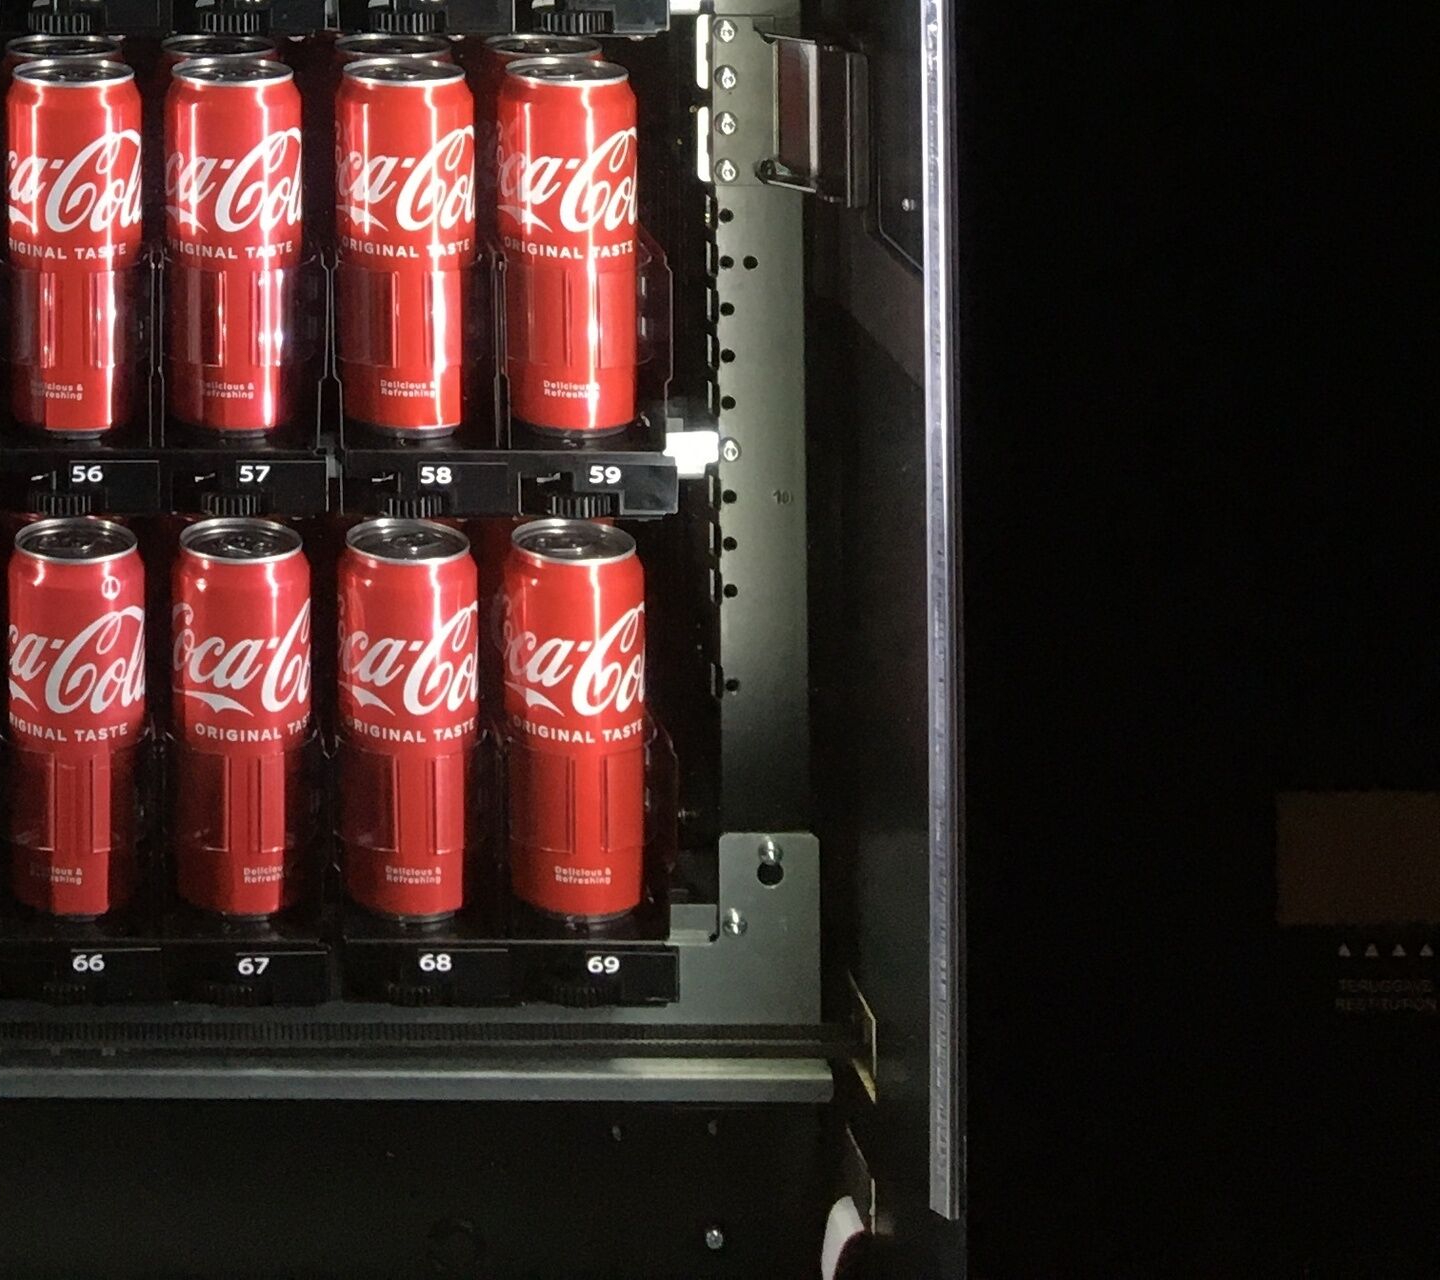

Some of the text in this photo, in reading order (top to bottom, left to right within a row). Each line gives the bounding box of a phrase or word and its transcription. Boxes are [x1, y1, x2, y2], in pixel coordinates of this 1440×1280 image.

[74, 243, 127, 260] TASTE
[245, 241, 293, 259] TASTE
[342, 236, 470, 258] ORIGINAL TASTE
[504, 237, 634, 259] ORIGINAL TASTE
[71, 465, 103, 483] 56
[239, 465, 271, 483] 57
[420, 466, 453, 485] 58
[588, 465, 622, 485] 59
[74, 722, 128, 742] TASTE
[195, 723, 282, 742] ORIGINAL
[347, 715, 475, 743] ORIGINAL TASTE
[514, 715, 643, 743] ORIGINAL TASTE
[72, 954, 105, 972] 66
[238, 957, 270, 975] 67
[419, 953, 452, 972] 68
[587, 956, 620, 974] 69
